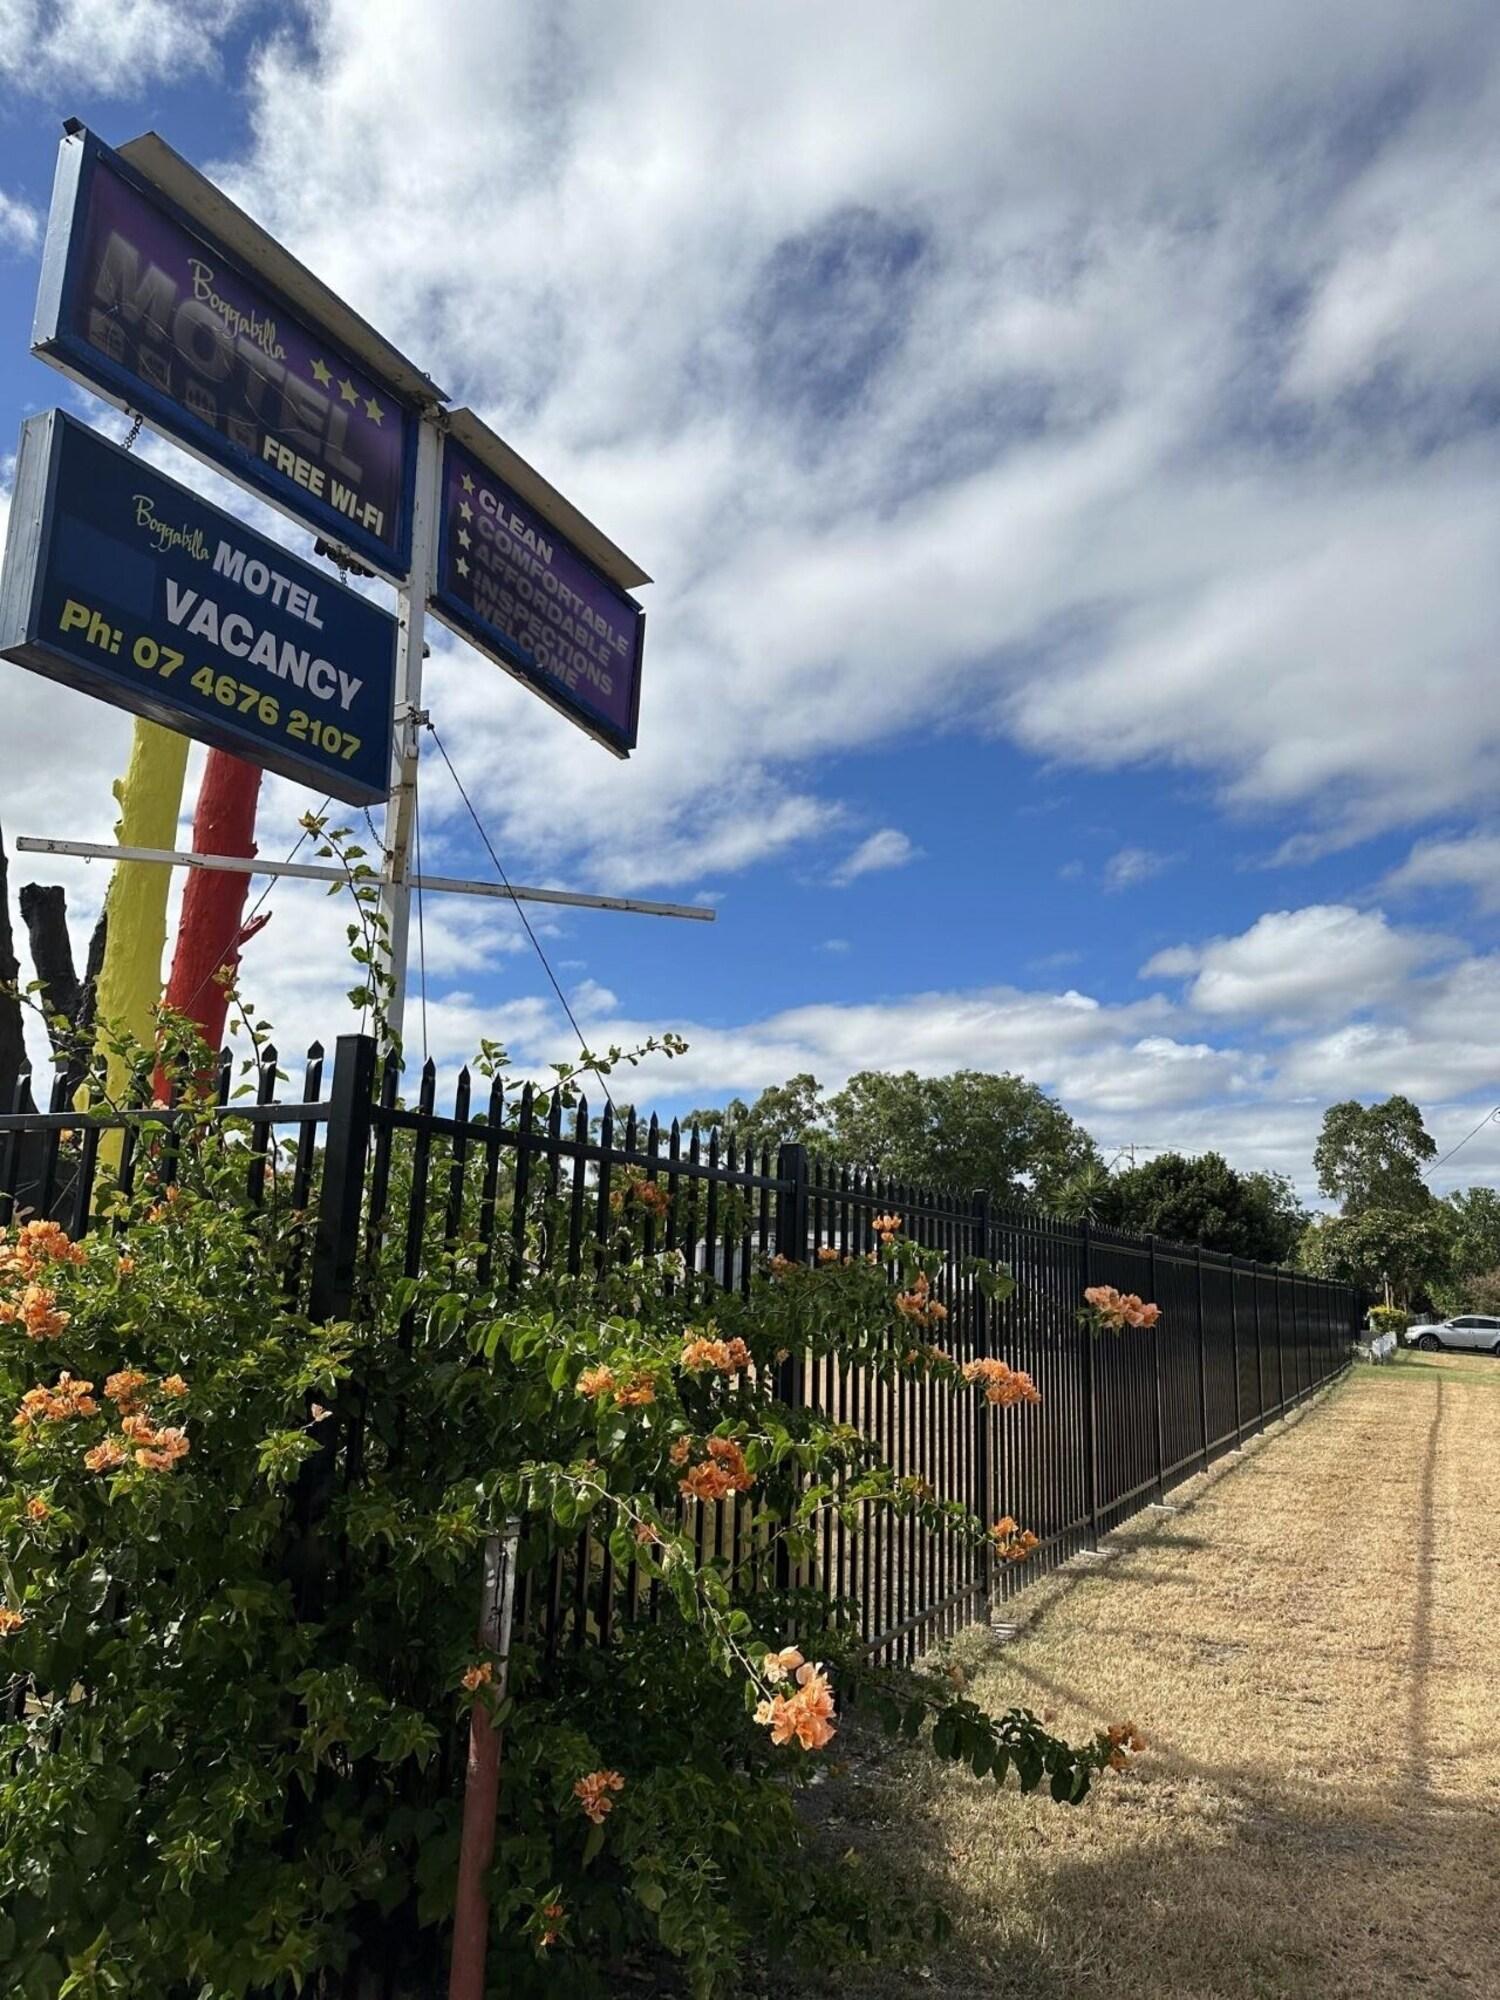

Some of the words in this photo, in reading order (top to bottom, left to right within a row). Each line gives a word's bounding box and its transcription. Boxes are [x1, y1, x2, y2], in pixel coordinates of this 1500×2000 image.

[94, 232, 363, 484] MOTEL
[187, 257, 287, 361] Boggabilla
[263, 434, 326, 499] FREE
[331, 478, 385, 536] WI-FI
[478, 488, 554, 565] CLEAN
[132, 494, 210, 562] Boggabilla
[212, 540, 324, 630] MOTEL
[475, 544, 610, 667] AFFORDABLE
[476, 515, 629, 657] COMFORTABLE
[59, 599, 124, 655] Ph:
[133, 638, 185, 678] 07
[191, 667, 280, 725] 4676
[286, 709, 362, 760] 2107
[165, 577, 364, 712] VACANCY
[472, 570, 614, 696] INSPECTIONS
[473, 597, 579, 690] WELCOME
